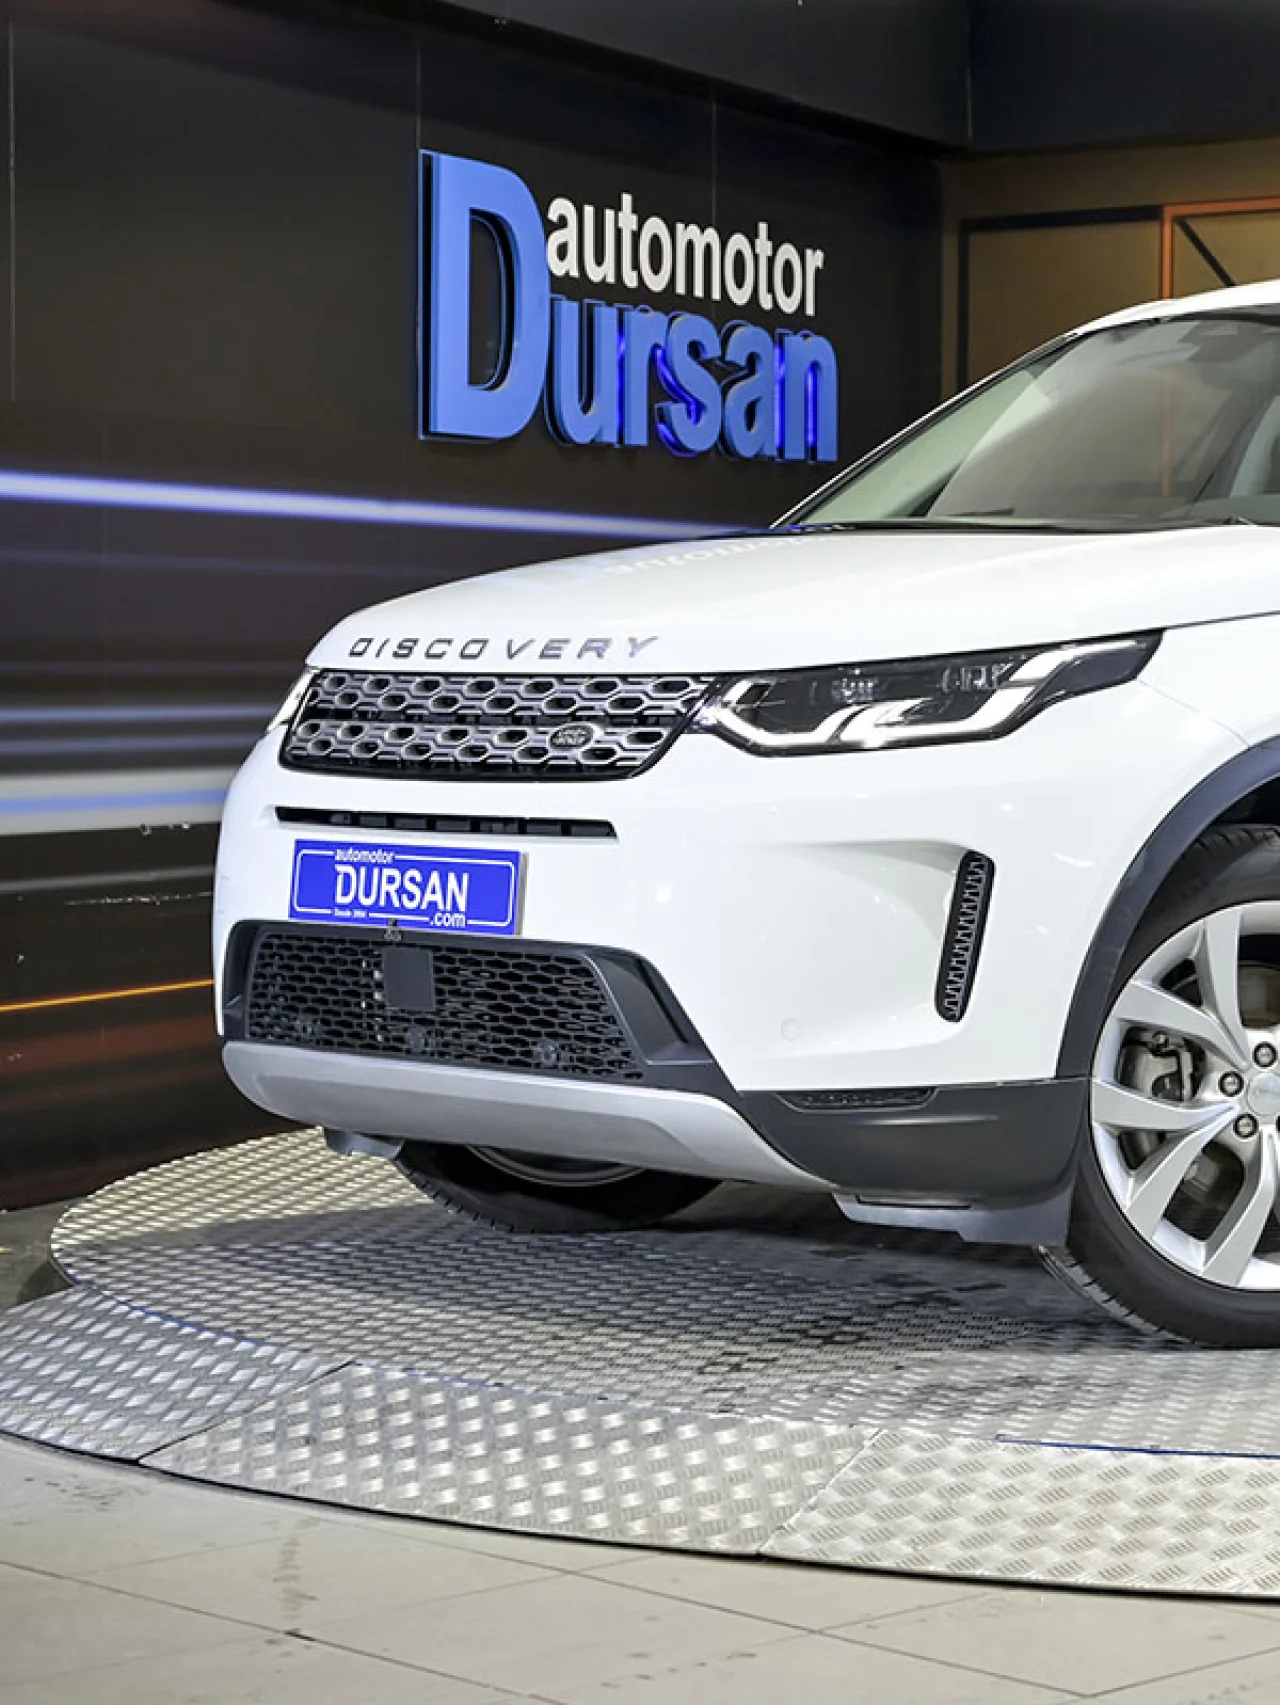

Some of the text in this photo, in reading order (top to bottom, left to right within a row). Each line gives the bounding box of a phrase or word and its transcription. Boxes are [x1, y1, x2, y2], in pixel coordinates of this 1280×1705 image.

[546, 192, 825, 316] automotor
[418, 148, 838, 464] Dursan
[349, 636, 658, 660] DISCOVERY
[334, 847, 394, 864] automotor
[334, 863, 470, 912] DURSAN
[430, 912, 466, 928] .com
